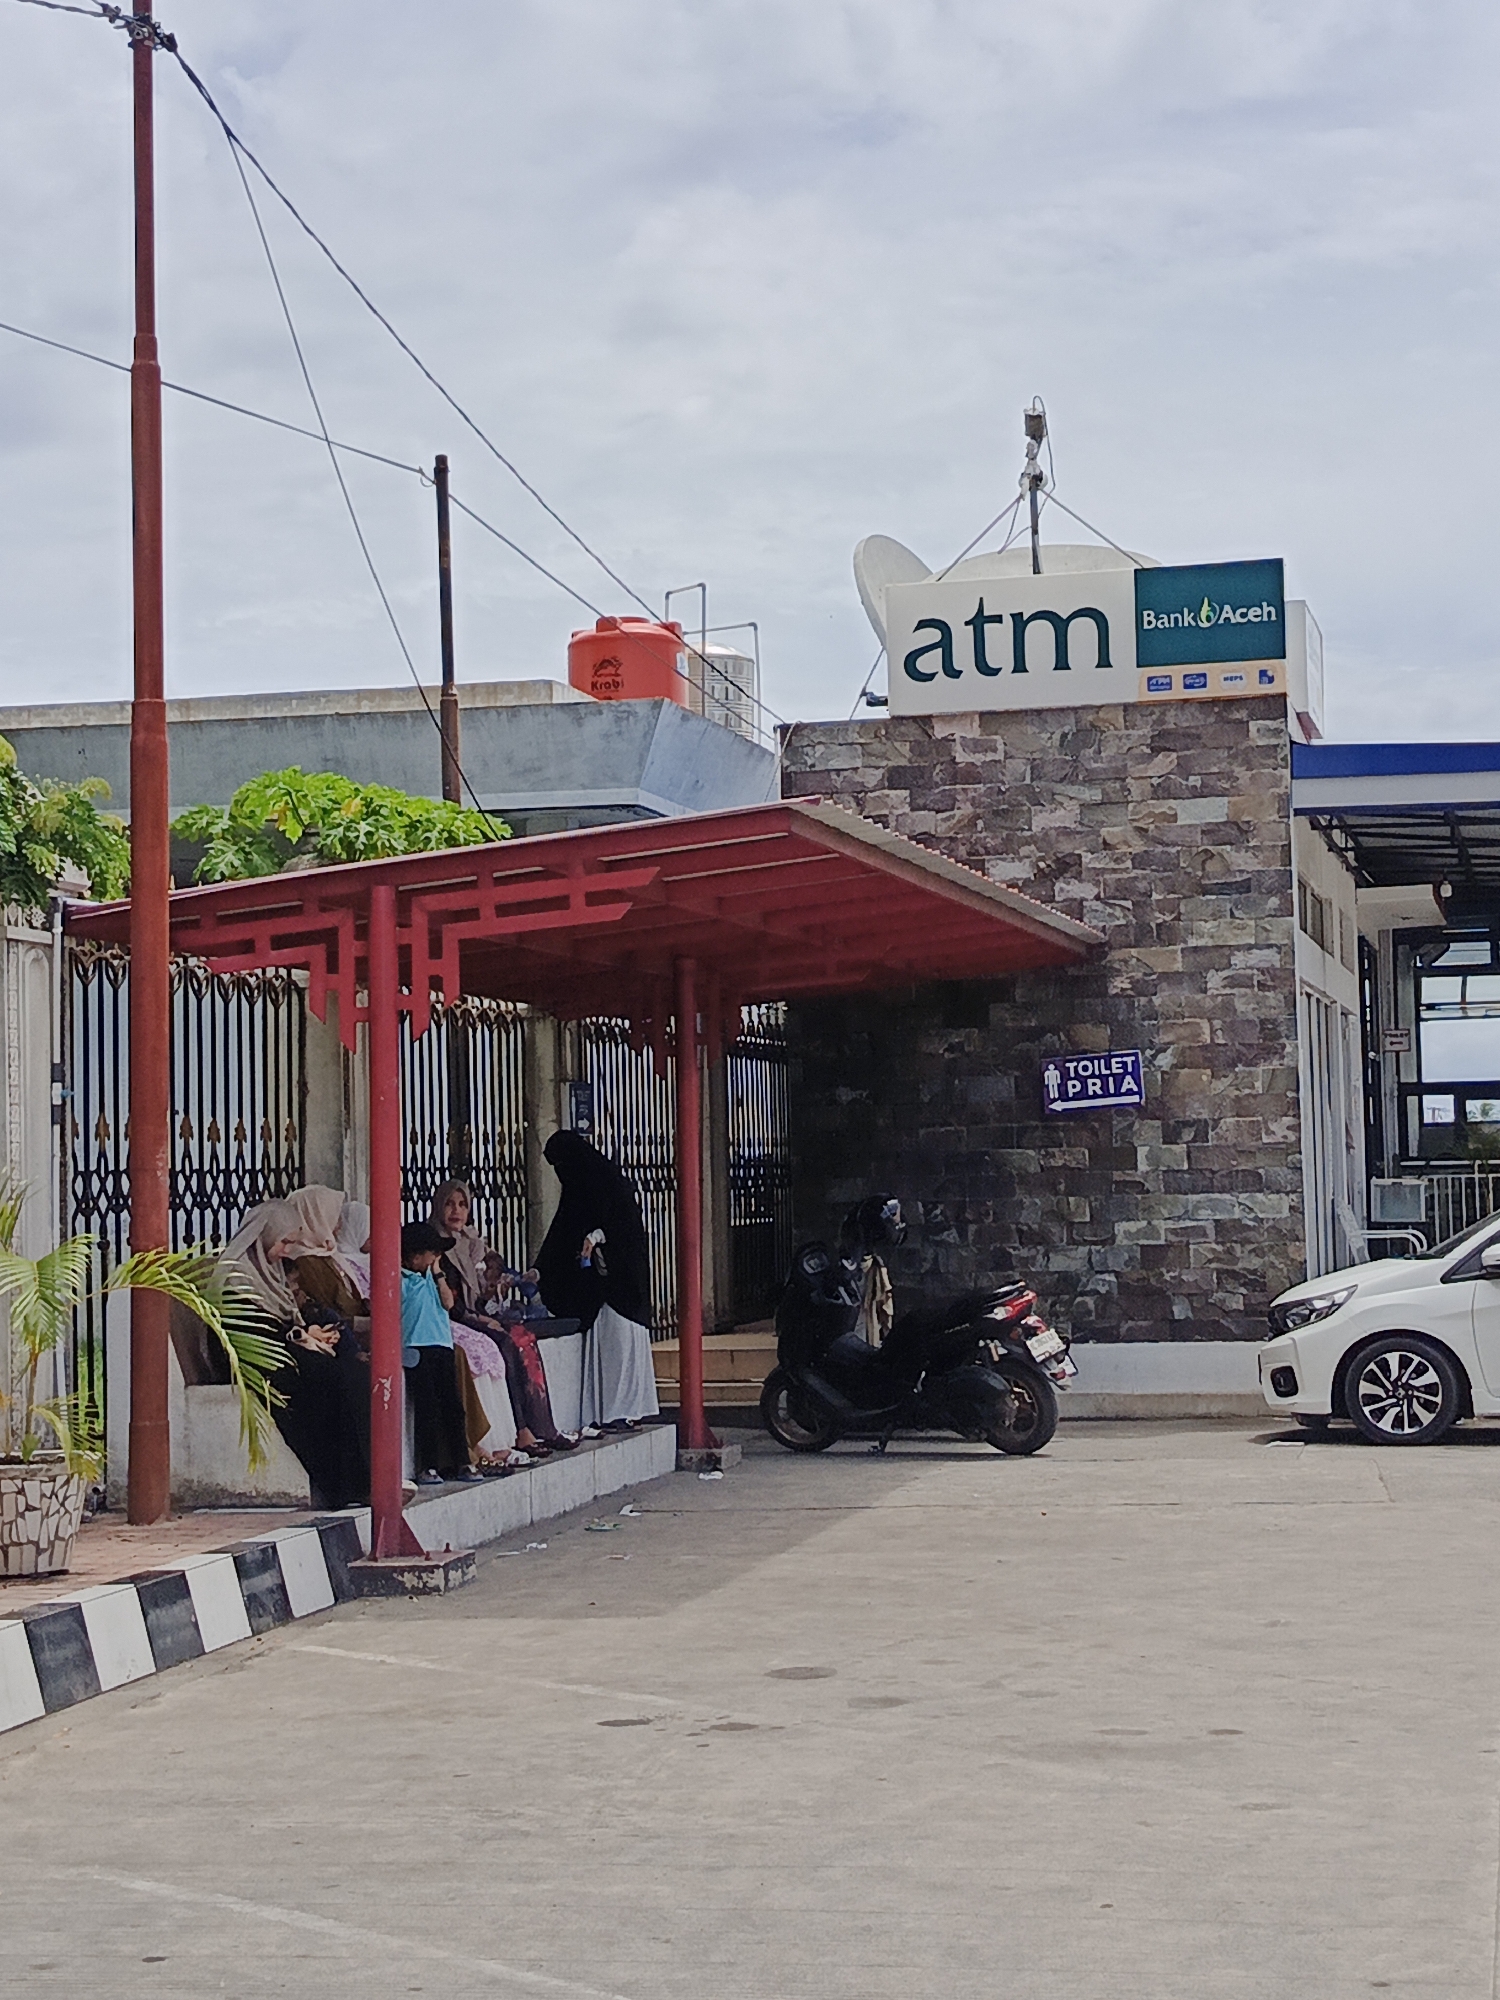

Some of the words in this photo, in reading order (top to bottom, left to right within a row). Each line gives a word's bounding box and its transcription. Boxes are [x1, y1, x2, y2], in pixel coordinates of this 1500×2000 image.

[1142, 607, 1196, 630] Bank
[1217, 602, 1277, 624] Aceh
[904, 597, 1114, 683] atm
[1065, 1056, 1135, 1077] TOILET
[1067, 1075, 1138, 1097] PRIA
